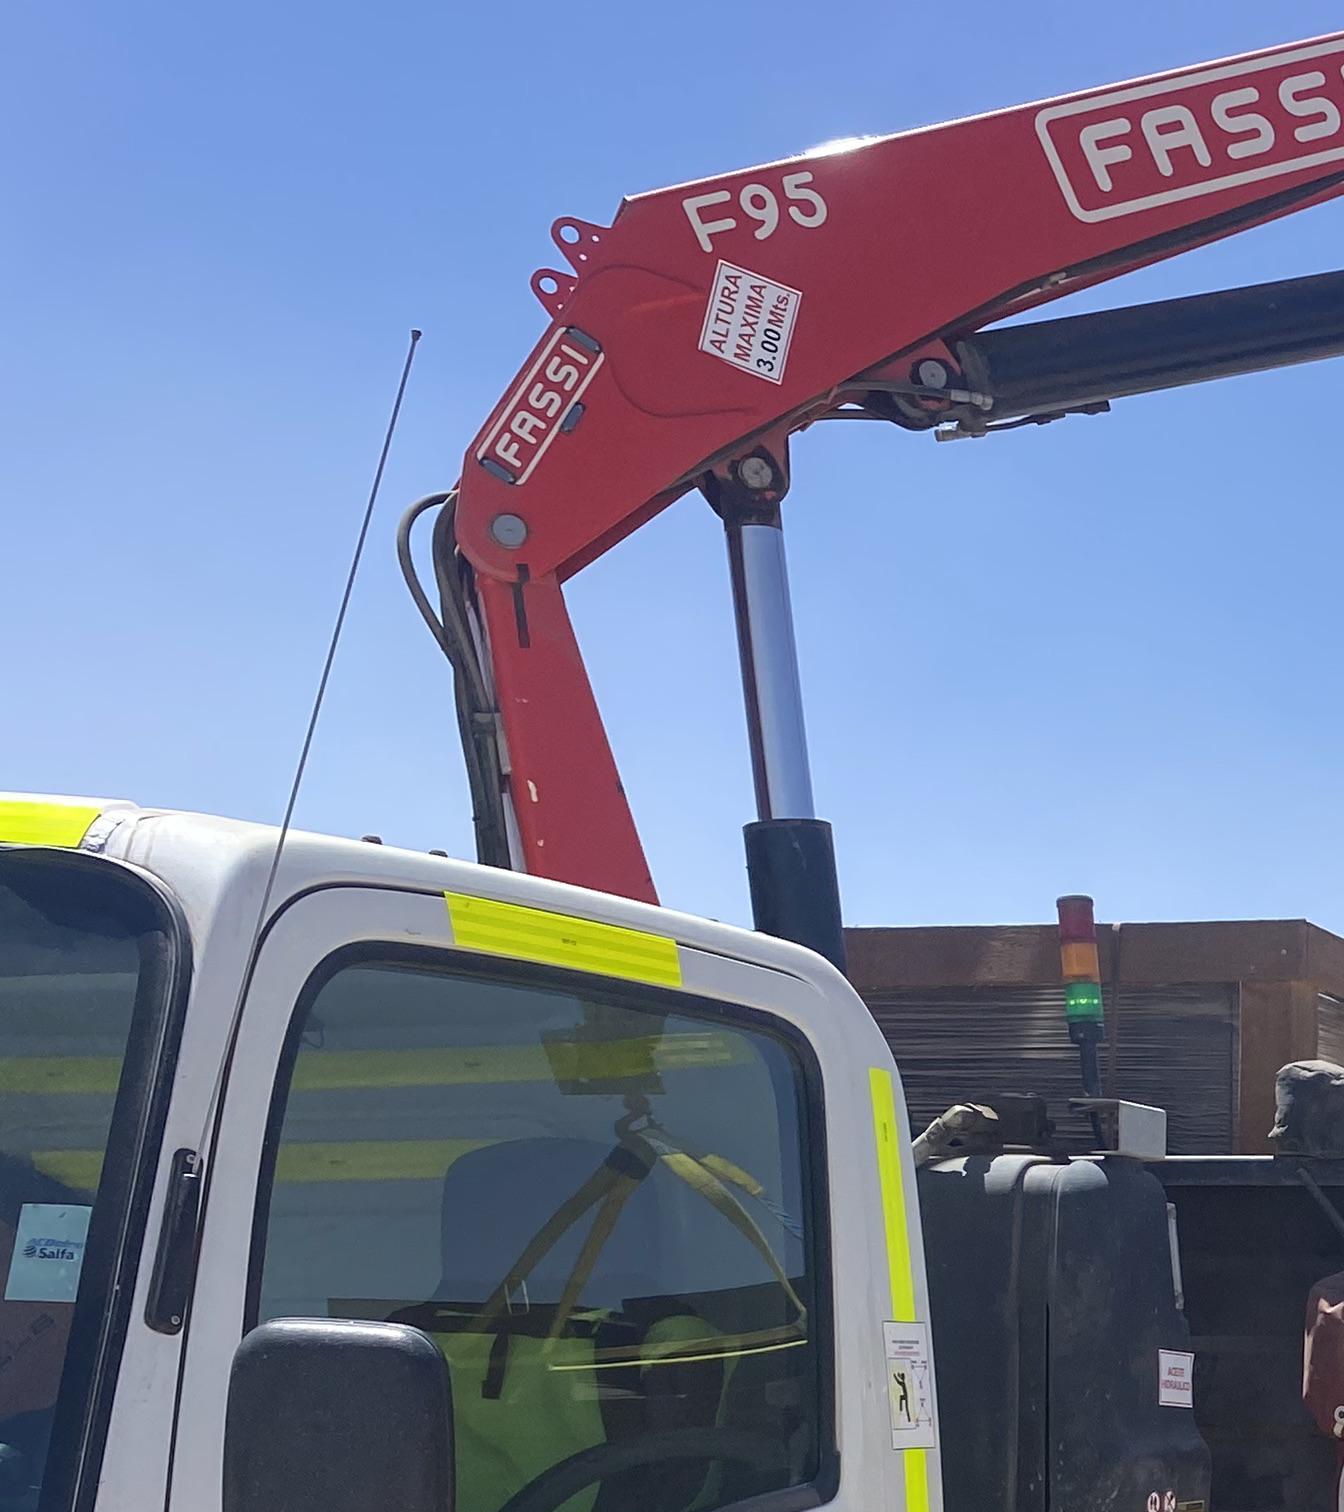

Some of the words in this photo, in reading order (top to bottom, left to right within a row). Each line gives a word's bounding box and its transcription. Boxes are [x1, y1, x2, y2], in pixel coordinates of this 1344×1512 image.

[682, 171, 828, 253] F95
[709, 274, 743, 355] ALTURA
[733, 284, 768, 363] MAXIMA
[756, 327, 782, 373] 3.00
[767, 293, 791, 329] Mts.
[494, 343, 590, 469] FASSI
[38, 1247, 75, 1260] Salfa
